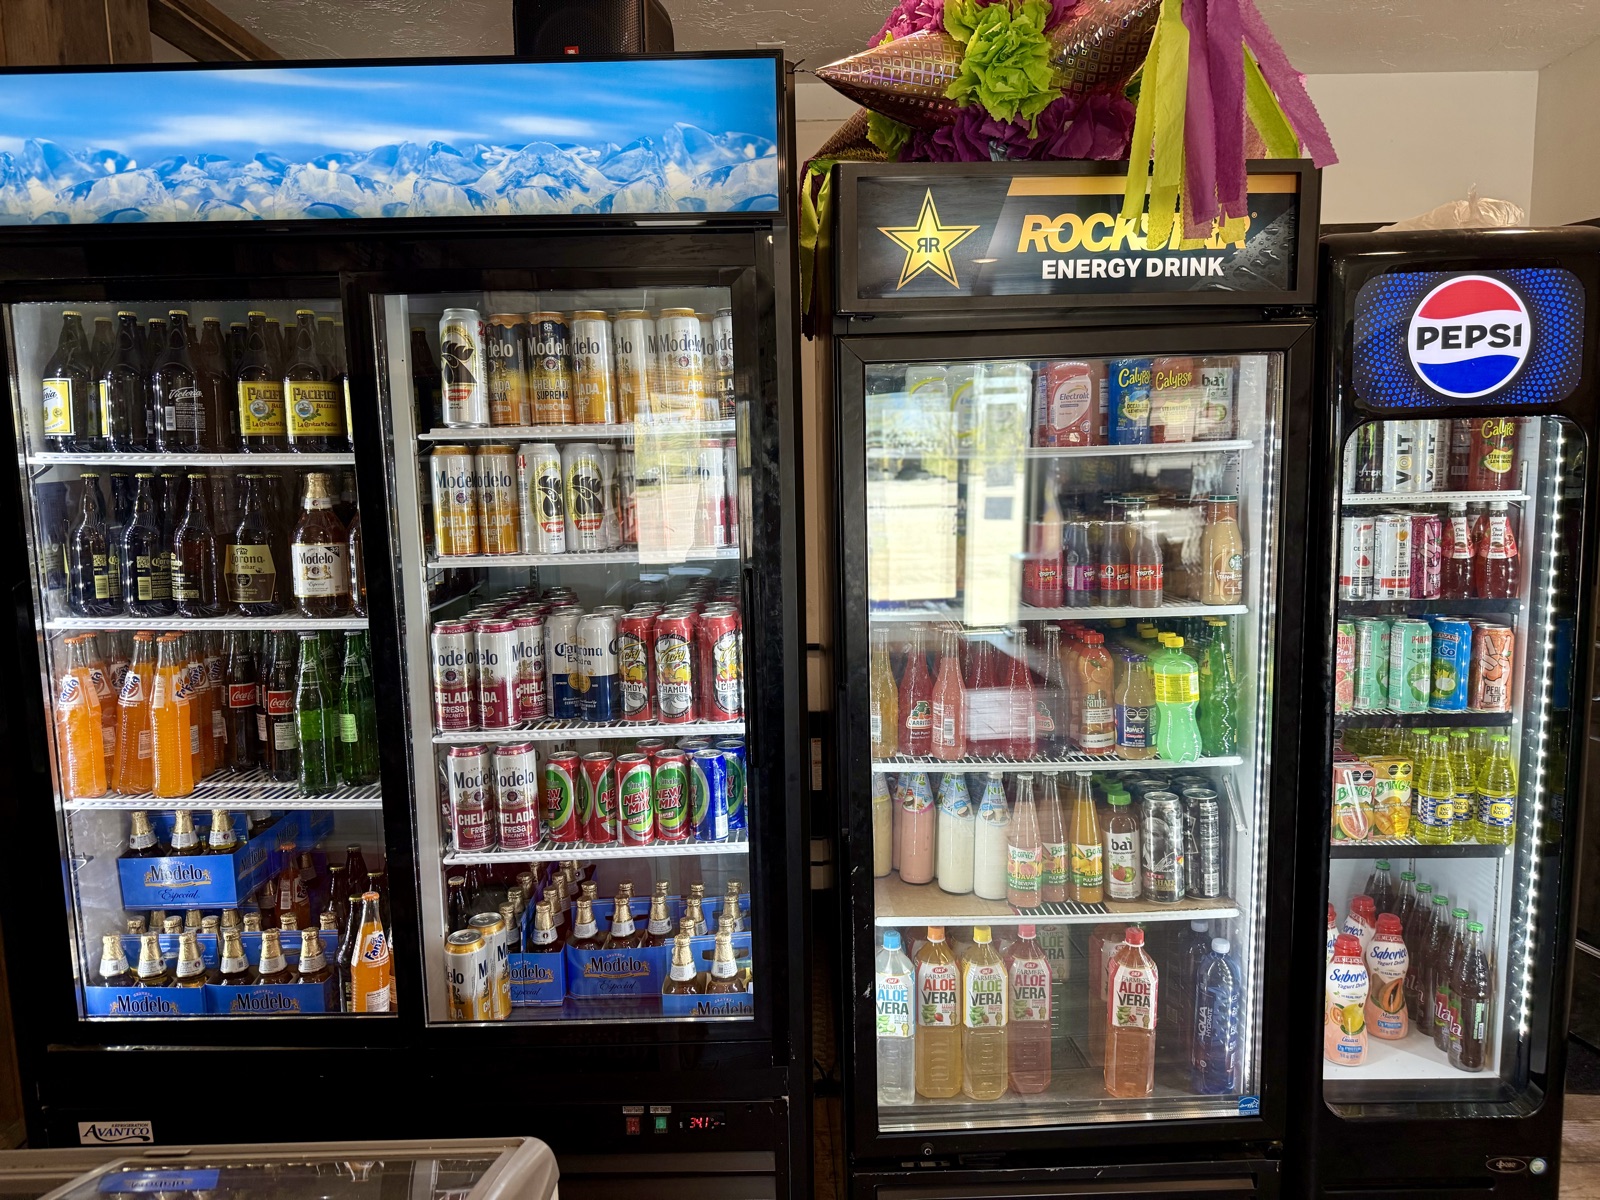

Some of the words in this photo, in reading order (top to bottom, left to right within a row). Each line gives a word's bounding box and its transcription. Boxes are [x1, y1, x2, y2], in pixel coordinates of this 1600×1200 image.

[1042, 257, 1142, 280] ENERGY
[1145, 256, 1225, 278] DRINK
[1416, 322, 1523, 351] PEPSI
[1155, 370, 1193, 391] Calypso
[168, 386, 204, 403] Victoria
[536, 389, 570, 400] SUPREMA
[1059, 393, 1090, 401] Electrolit
[1396, 433, 1413, 486] VOLT
[299, 552, 334, 565] Modelo
[433, 649, 474, 668] odelo
[659, 684, 688, 694] CHAMOY
[1488, 694, 1501, 703] TEA
[495, 768, 535, 788] odelo
[655, 784, 683, 800] NEW
[1376, 779, 1411, 797] BOING!
[623, 787, 651, 806] NEW
[658, 798, 682, 810] MIX
[627, 802, 651, 815] MIX
[150, 864, 203, 882] Modelo
[159, 888, 200, 905] Especial
[364, 932, 384, 961] Fanta
[511, 964, 546, 979] odelo
[590, 956, 642, 973] Modelo
[924, 972, 956, 980] FARMER'S
[972, 973, 1001, 981] FARMER'S
[1014, 974, 1046, 987] ALOE
[598, 979, 637, 993] Especial
[923, 978, 957, 991] ALOE
[972, 979, 1003, 993] ALOE
[1011, 984, 1047, 1000] VERA
[1119, 981, 1151, 996] ALOE
[117, 994, 171, 1013] Modelo
[236, 992, 292, 1011] Modelo
[876, 989, 909, 1002] ALOE
[920, 989, 957, 1005] VERA
[969, 990, 1003, 1007] VERA
[1116, 990, 1151, 1008] VERA
[697, 1000, 753, 1016] Modelo
[875, 1001, 909, 1015] VERA
[1205, 1006, 1213, 1038] HYDRATE
[82, 1123, 150, 1141] AVANTCO
